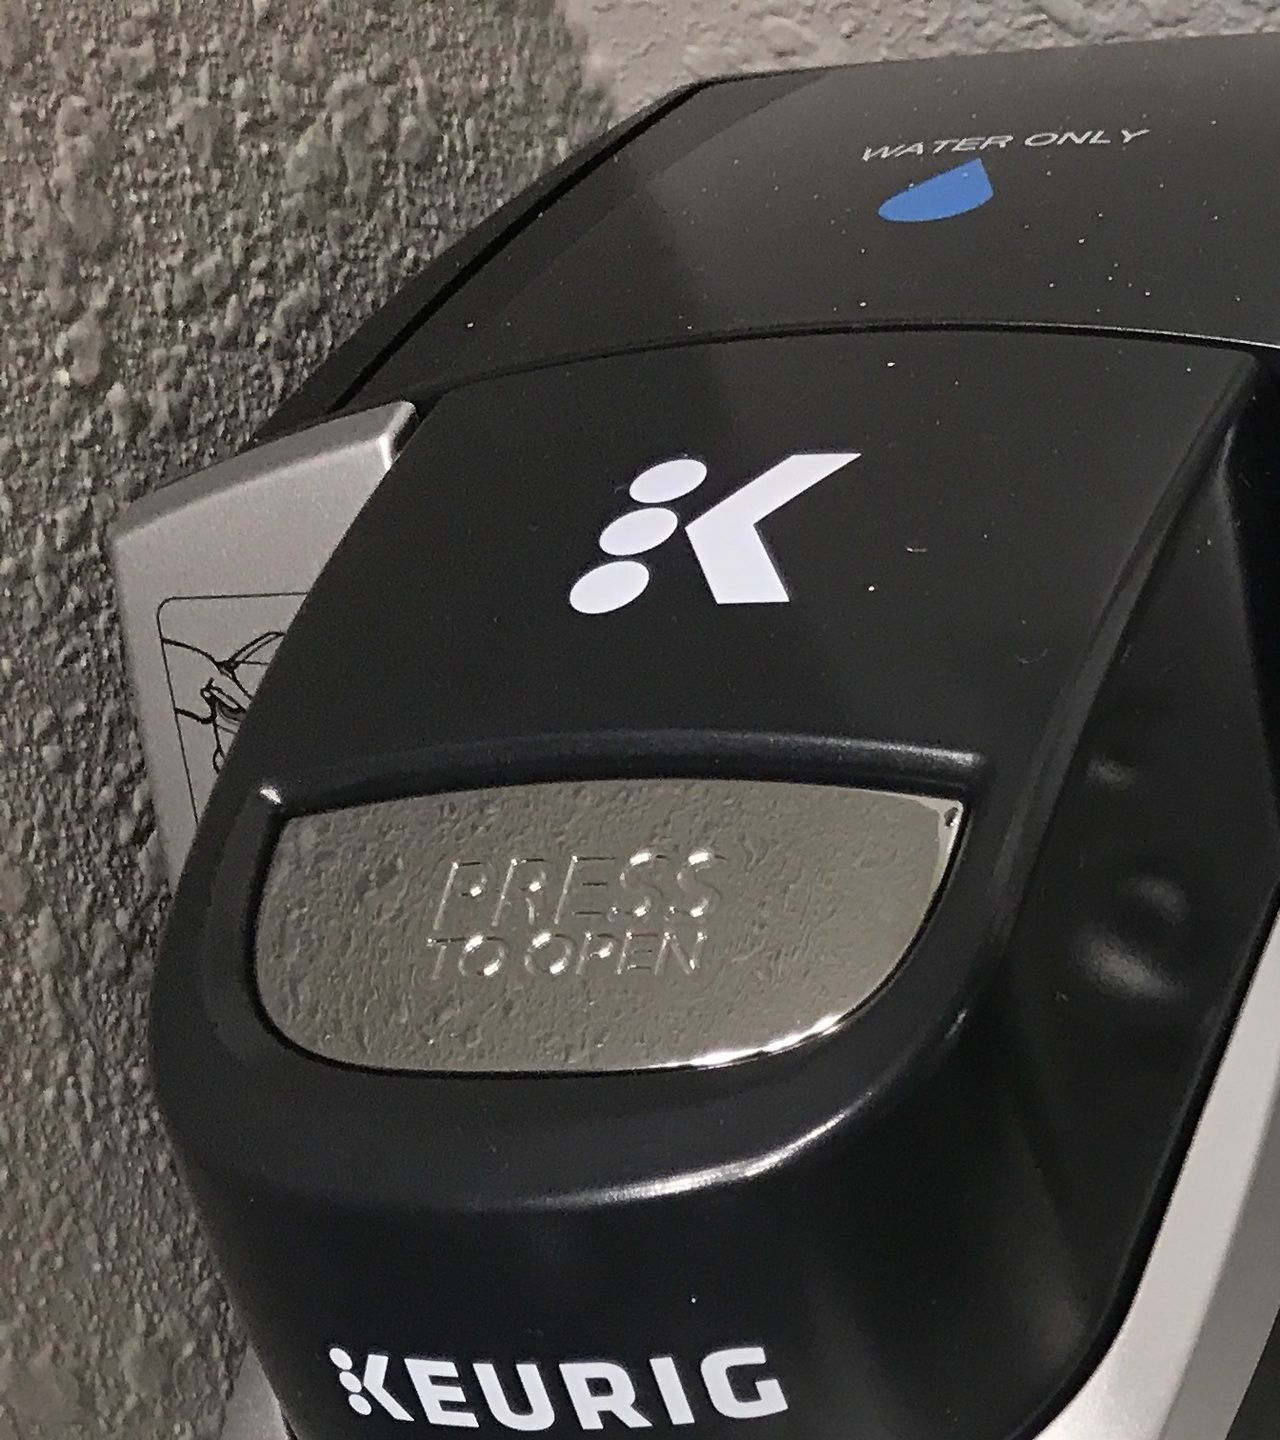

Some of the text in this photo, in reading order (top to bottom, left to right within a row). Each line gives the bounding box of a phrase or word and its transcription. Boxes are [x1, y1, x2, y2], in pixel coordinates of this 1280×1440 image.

[863, 127, 1150, 161] WATER ONLY
[433, 851, 727, 929] PRESS
[426, 930, 709, 980] TO OPEN
[329, 1345, 788, 1432] KEURIG
